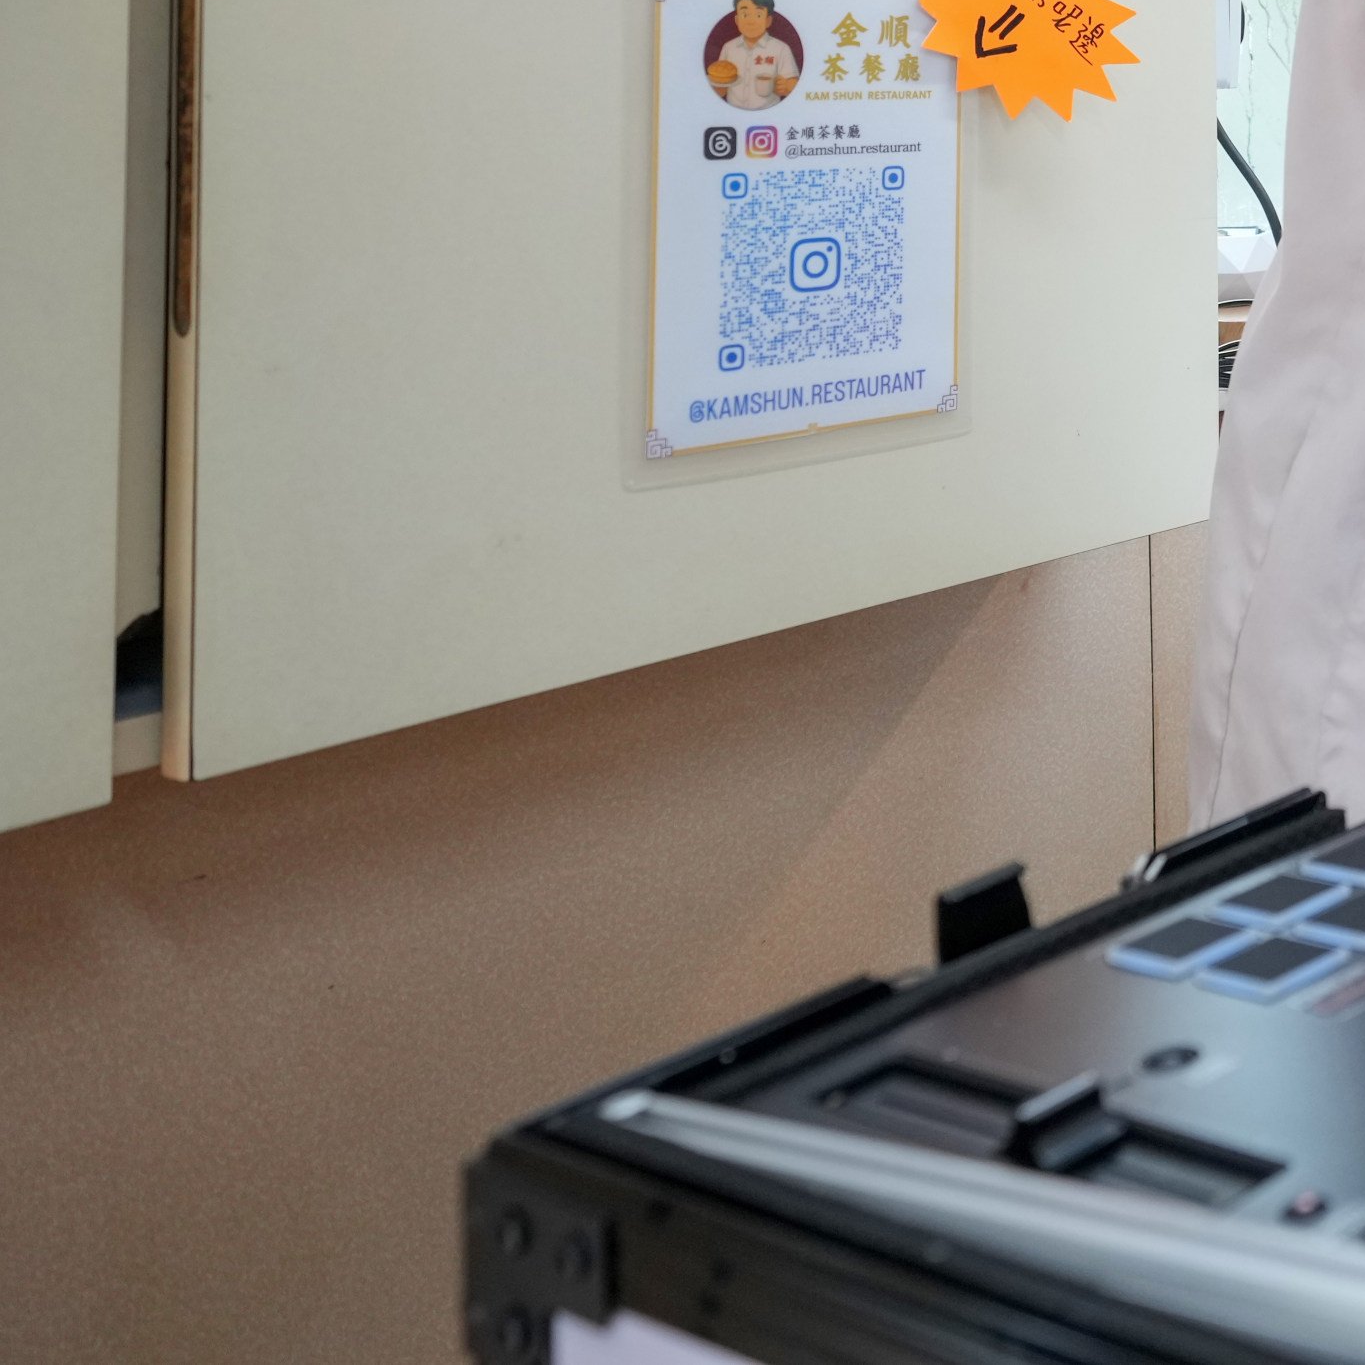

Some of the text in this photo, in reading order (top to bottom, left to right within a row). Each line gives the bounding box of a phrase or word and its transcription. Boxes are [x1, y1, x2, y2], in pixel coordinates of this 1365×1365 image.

[831, 11, 911, 49] 金順
[821, 52, 921, 84] 茶餐廳
[805, 90, 932, 101] KAM SHUN RESTAURANT
[786, 123, 861, 141] 金順茶餐廳
[784, 140, 922, 159] @kamshun.restaurant
[688, 368, 927, 424] @KAMSHUN.RESTAURANT
